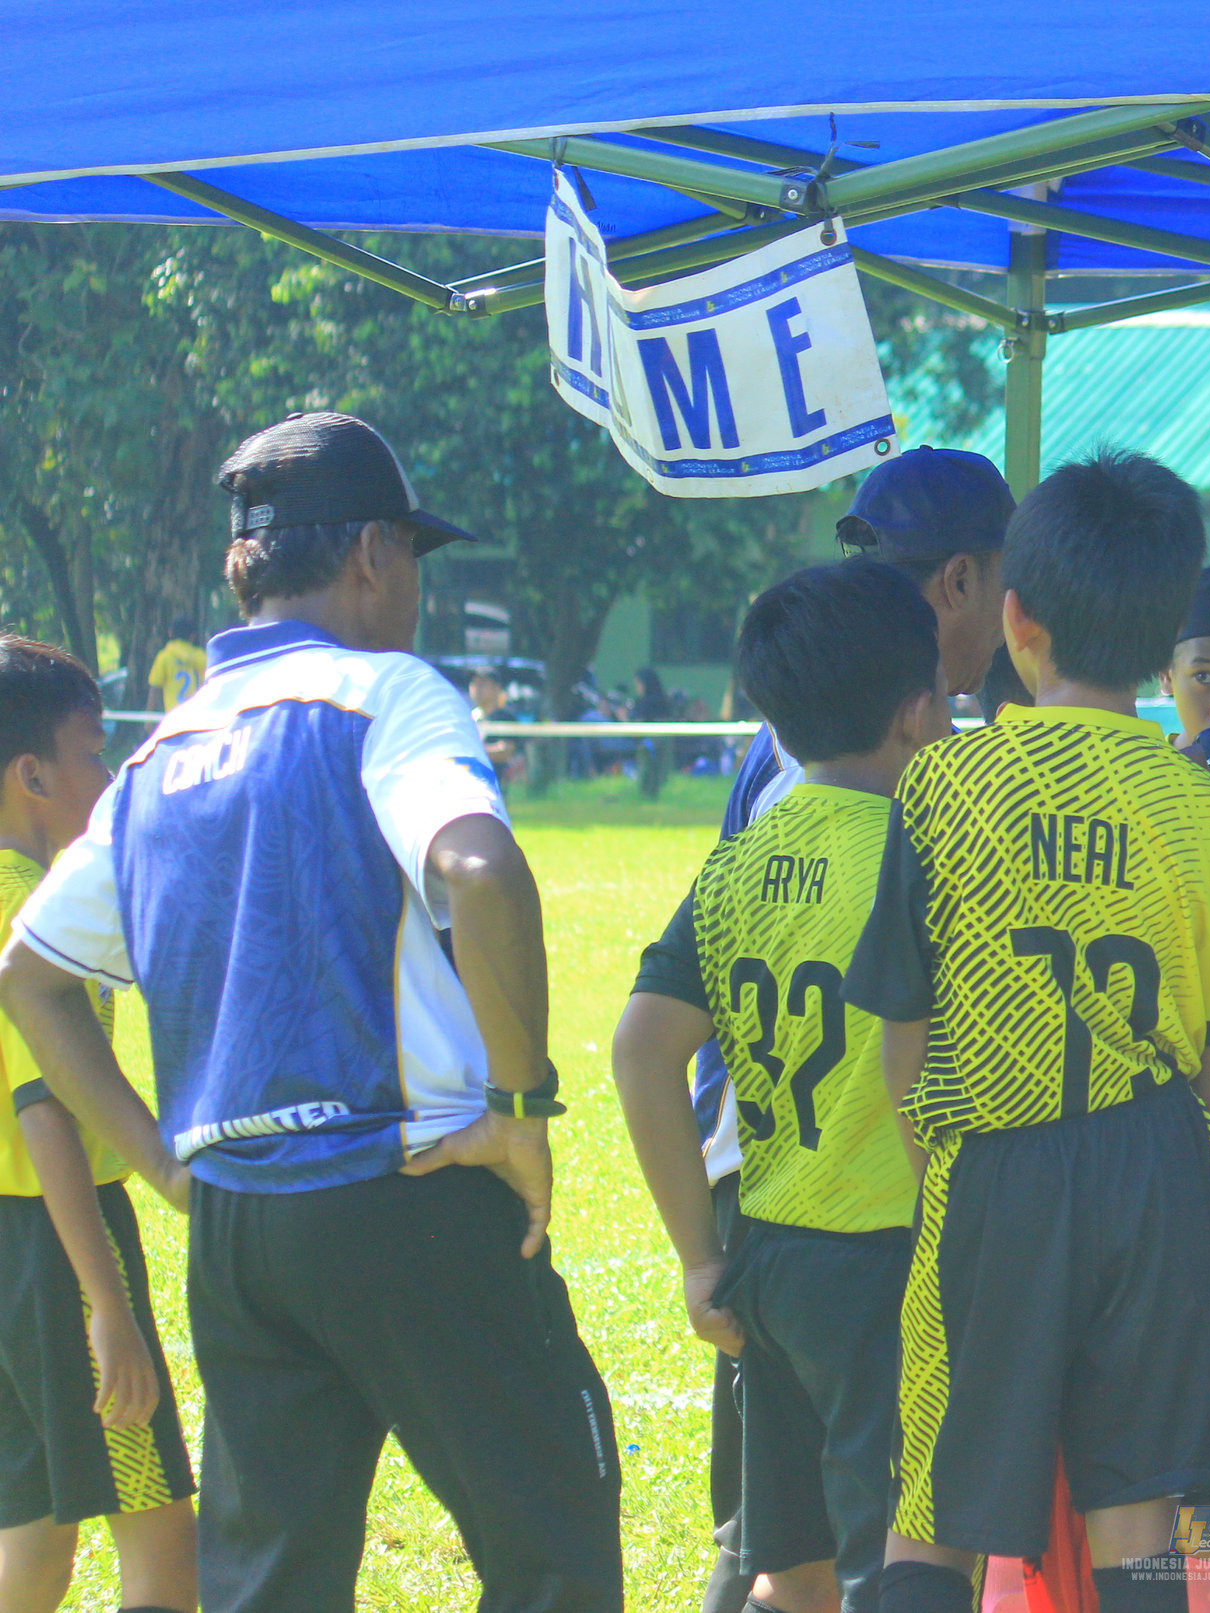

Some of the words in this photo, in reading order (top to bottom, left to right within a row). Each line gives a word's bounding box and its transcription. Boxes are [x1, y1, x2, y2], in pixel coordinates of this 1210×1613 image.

[760, 855, 829, 904] ARYA
[1030, 811, 1135, 891] NEAL
[729, 957, 846, 1152] 32
